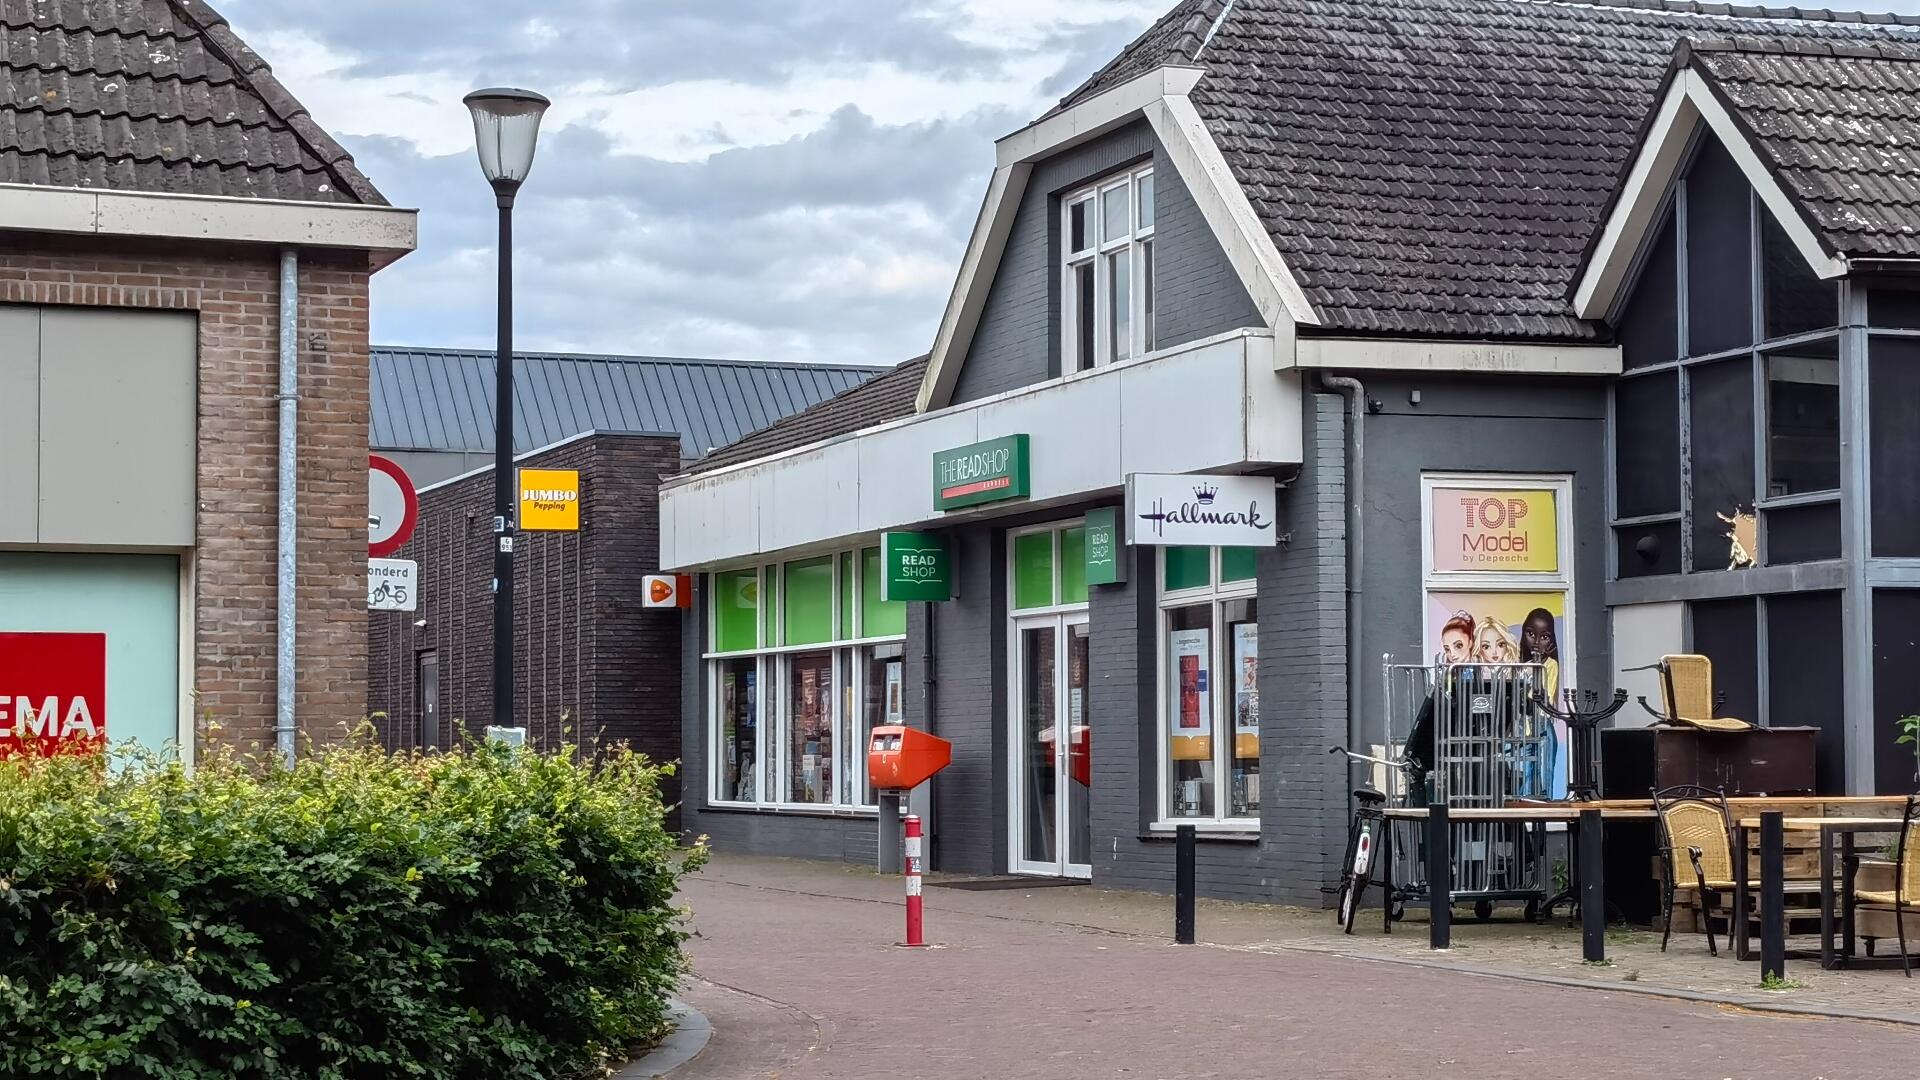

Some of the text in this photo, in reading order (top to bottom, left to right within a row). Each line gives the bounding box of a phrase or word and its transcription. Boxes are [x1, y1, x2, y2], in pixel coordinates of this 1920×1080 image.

[522, 489, 577, 502] JUMBO
[533, 501, 566, 512] Pepping
[1460, 497, 1529, 529] TOP
[1138, 497, 1273, 538] Hallmark
[1092, 532, 1109, 546] READ
[1462, 530, 1529, 552] Model
[1092, 545, 1109, 558] SHOP
[902, 555, 936, 566] READ
[1462, 553, 1529, 564] by Depesche
[902, 566, 936, 577] SHOP
